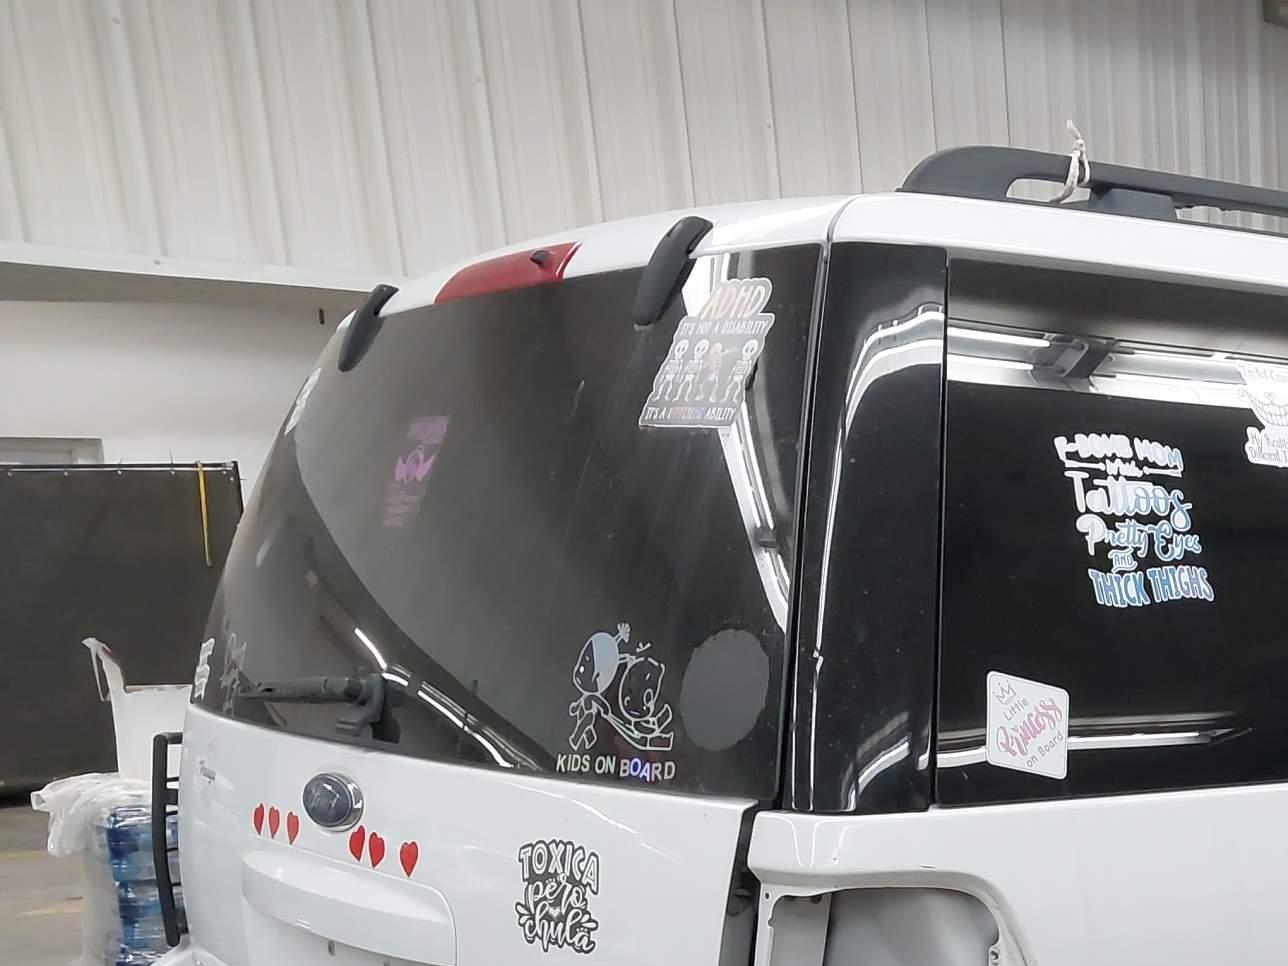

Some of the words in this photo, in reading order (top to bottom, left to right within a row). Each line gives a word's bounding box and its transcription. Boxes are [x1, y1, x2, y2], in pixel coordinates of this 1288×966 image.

[704, 406, 737, 421] ABILITY
[1064, 470, 1193, 532] Tattoos
[1076, 513, 1149, 558] Pretty
[1153, 519, 1202, 562] Eyes
[1088, 568, 1151, 608] THICK
[1146, 565, 1215, 603] THIGHS
[1003, 698, 1029, 721] Little
[556, 753, 591, 773] KIDS
[594, 755, 617, 774] ON
[619, 757, 676, 782] BOARD
[1026, 754, 1039, 768] on
[1037, 730, 1065, 757] Board
[519, 840, 599, 895] TOXICA
